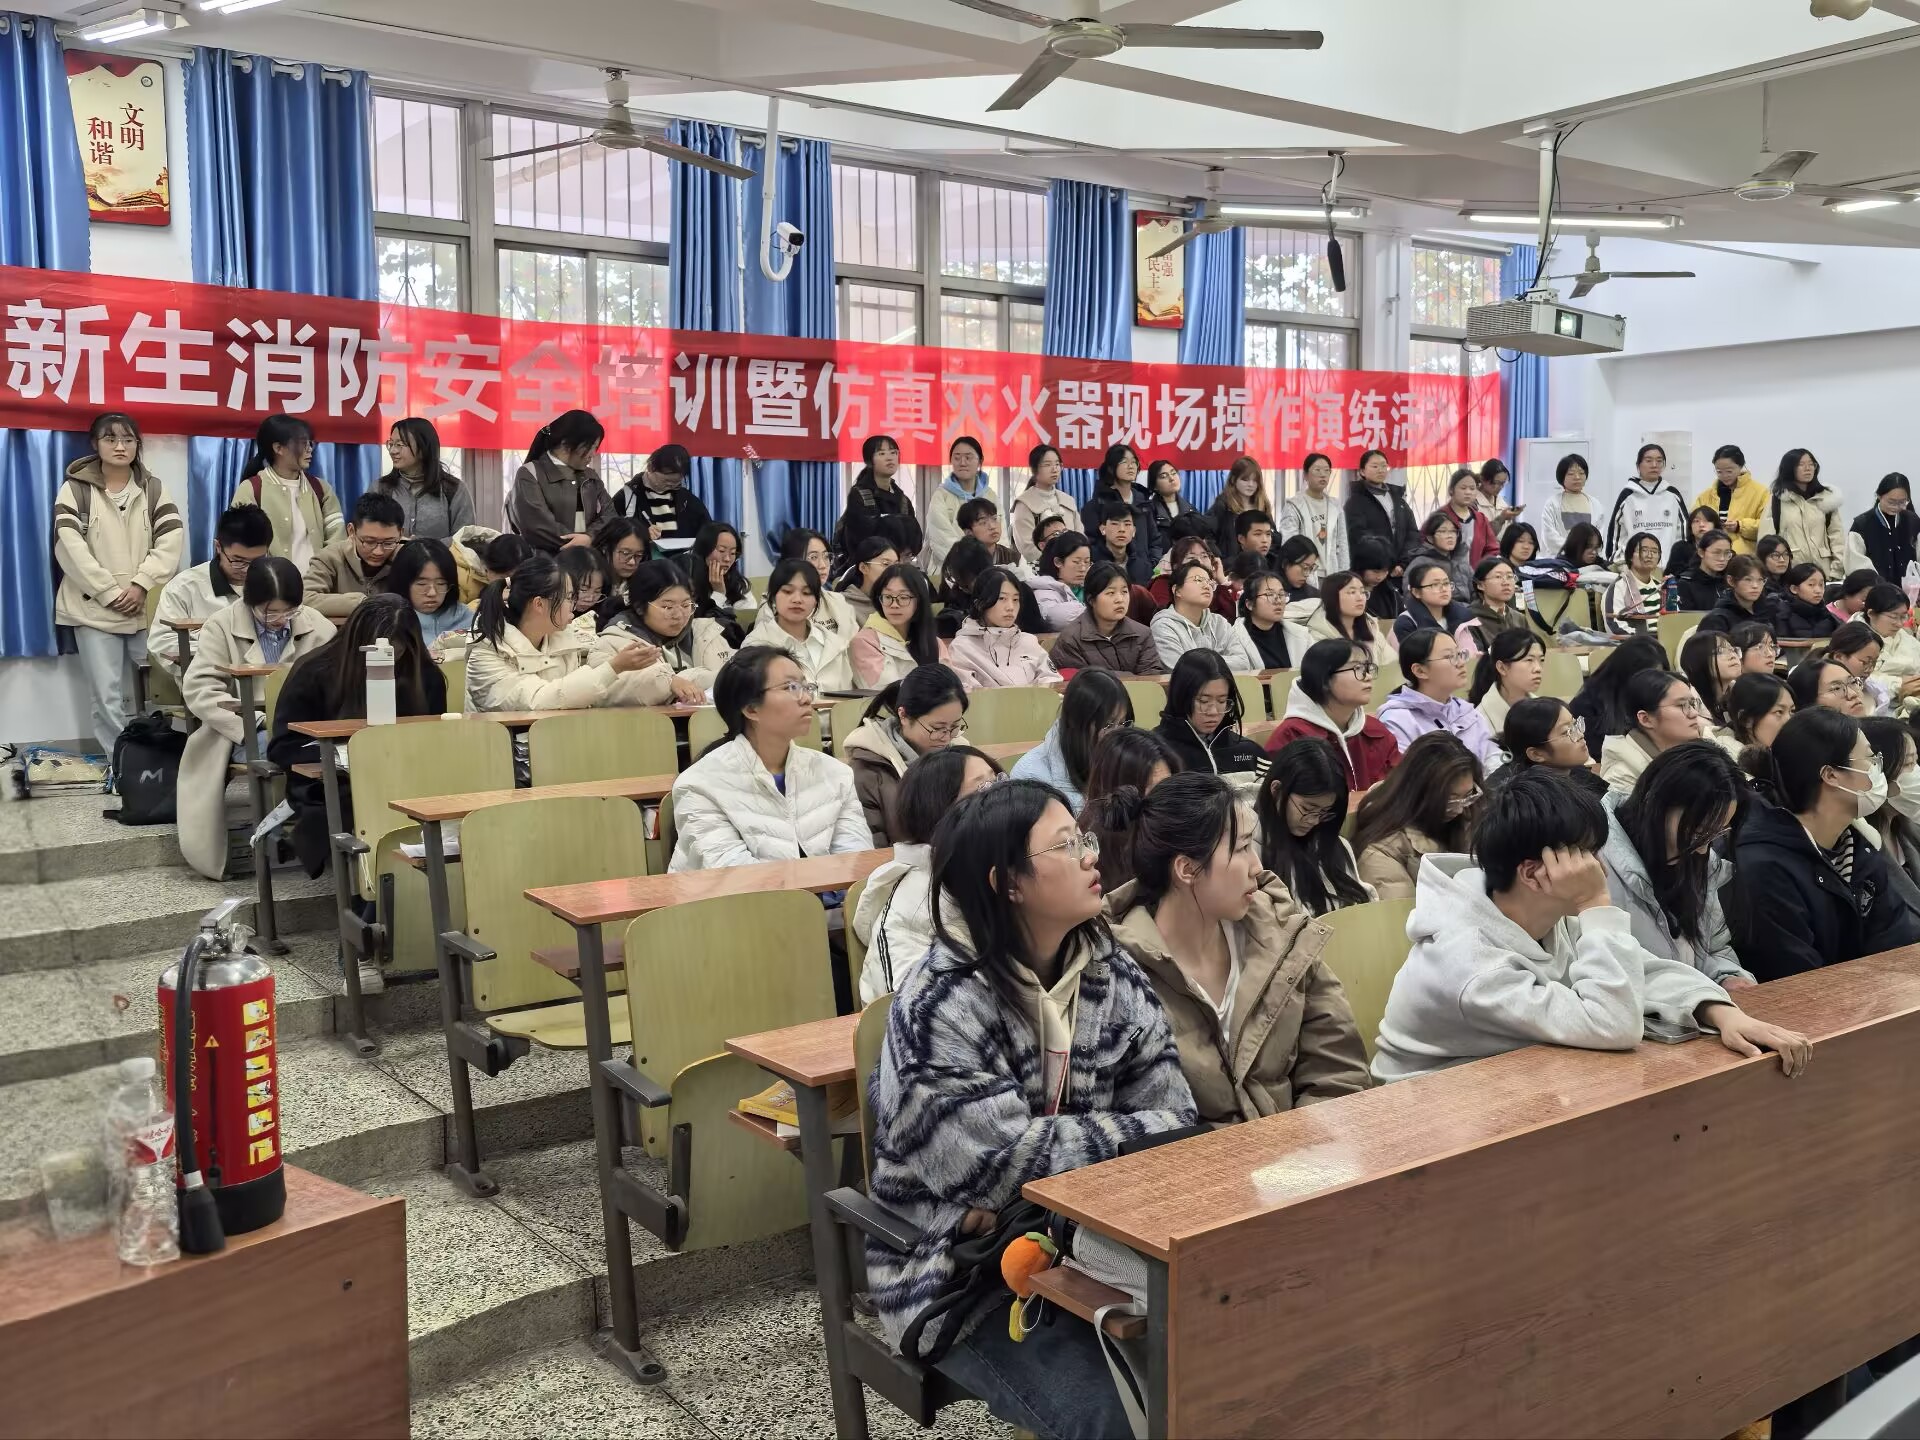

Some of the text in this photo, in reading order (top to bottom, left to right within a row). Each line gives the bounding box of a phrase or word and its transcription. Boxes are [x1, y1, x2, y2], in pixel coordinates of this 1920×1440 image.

[87, 116, 115, 166] 和谐
[119, 102, 145, 151] 文明
[1144, 256, 1161, 289] 民主
[5, 298, 1457, 452] 新生消防安全培训暨仿真灭火器现场操作演练活动
